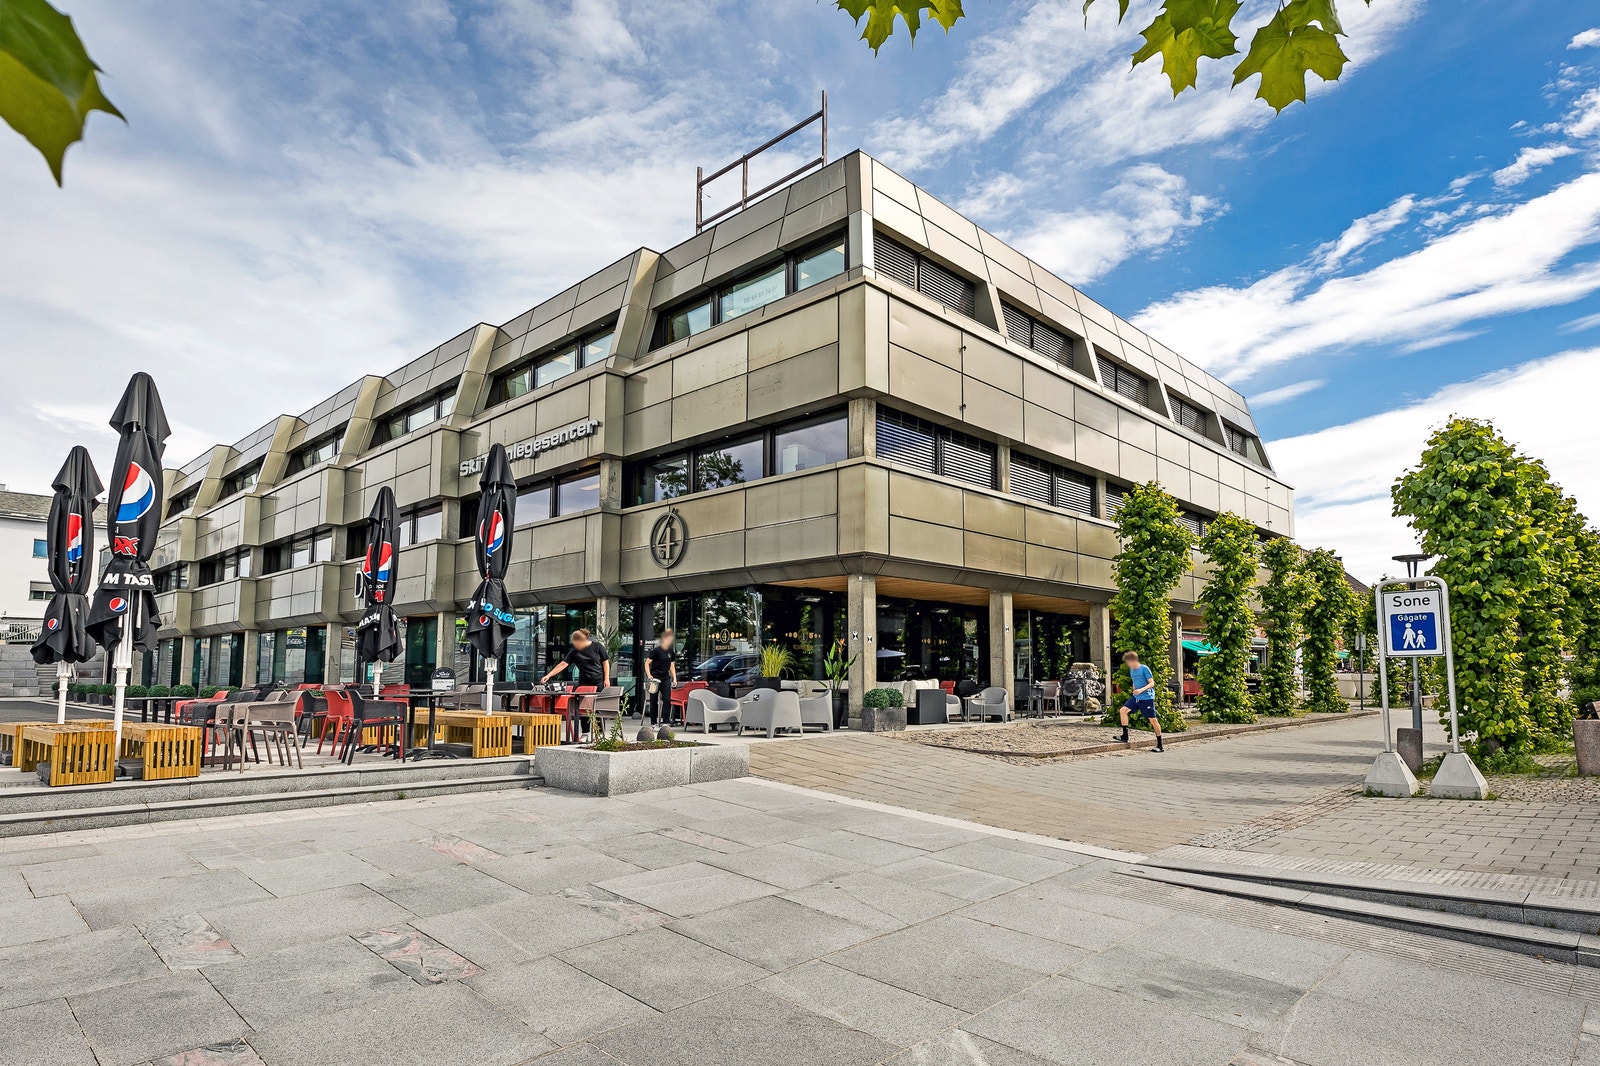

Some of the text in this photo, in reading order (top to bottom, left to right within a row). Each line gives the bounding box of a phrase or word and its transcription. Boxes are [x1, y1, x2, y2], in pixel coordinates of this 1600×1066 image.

[459, 419, 599, 477] Ski Tnlegesenter
[114, 536, 141, 557] AX
[123, 573, 153, 586] TAST
[1393, 596, 1430, 607] Sone
[493, 607, 516, 624] SUGA
[1397, 614, 1428, 622] Gågate
